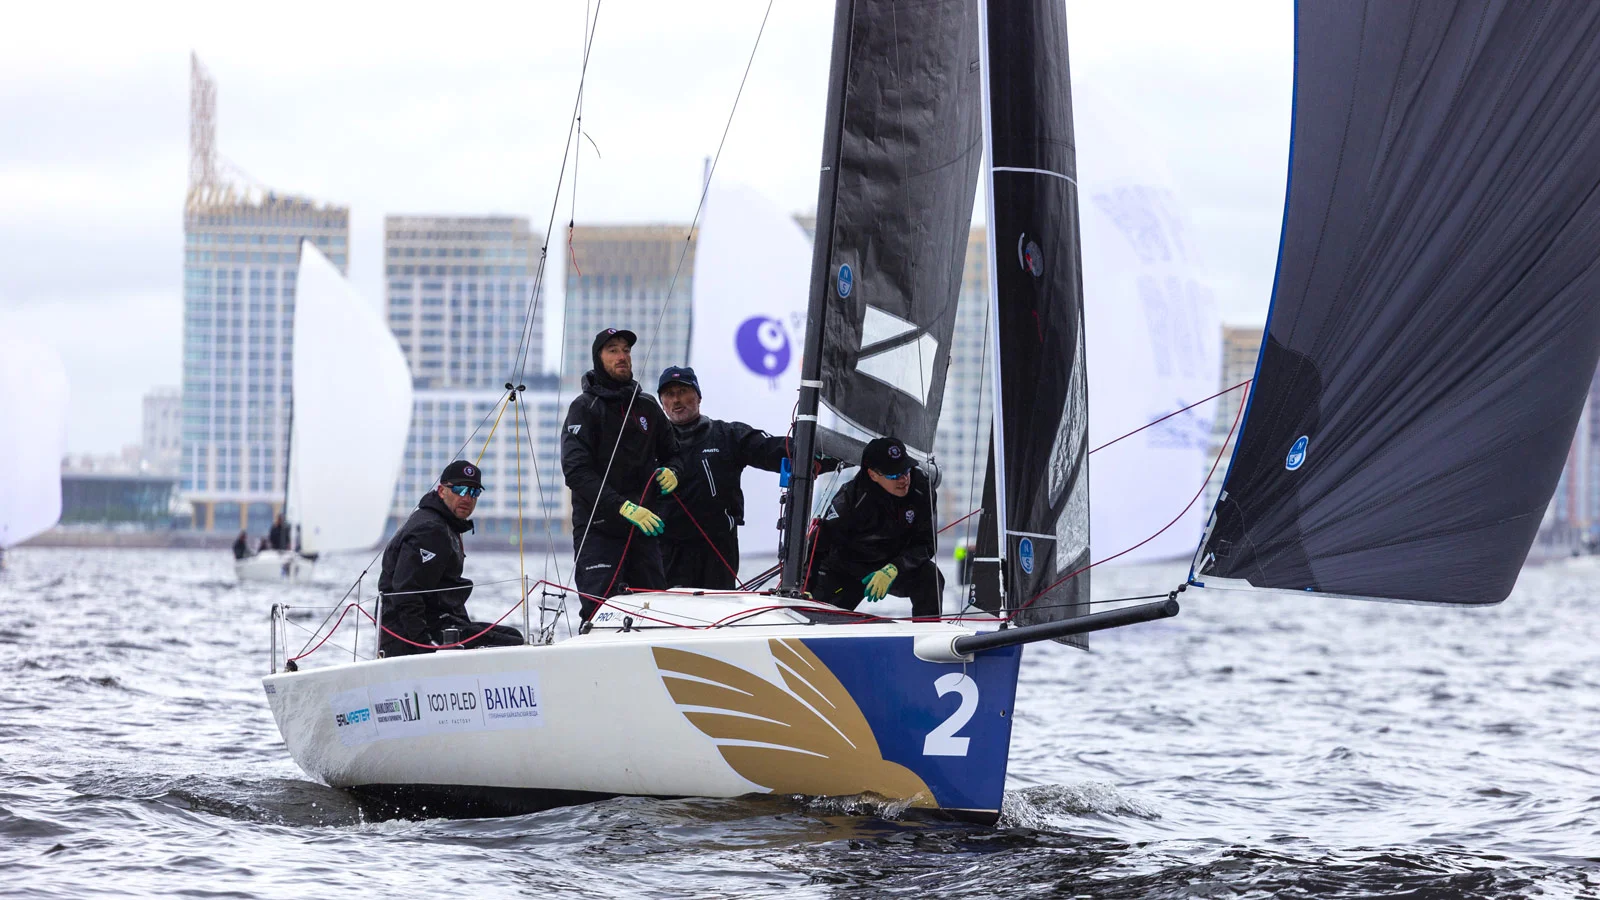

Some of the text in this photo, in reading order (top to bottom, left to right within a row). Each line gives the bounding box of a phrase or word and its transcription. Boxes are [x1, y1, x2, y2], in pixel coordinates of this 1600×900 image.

[450, 692, 477, 711] PLED
[484, 685, 537, 710] BAIKAL
[922, 672, 979, 757] 2
